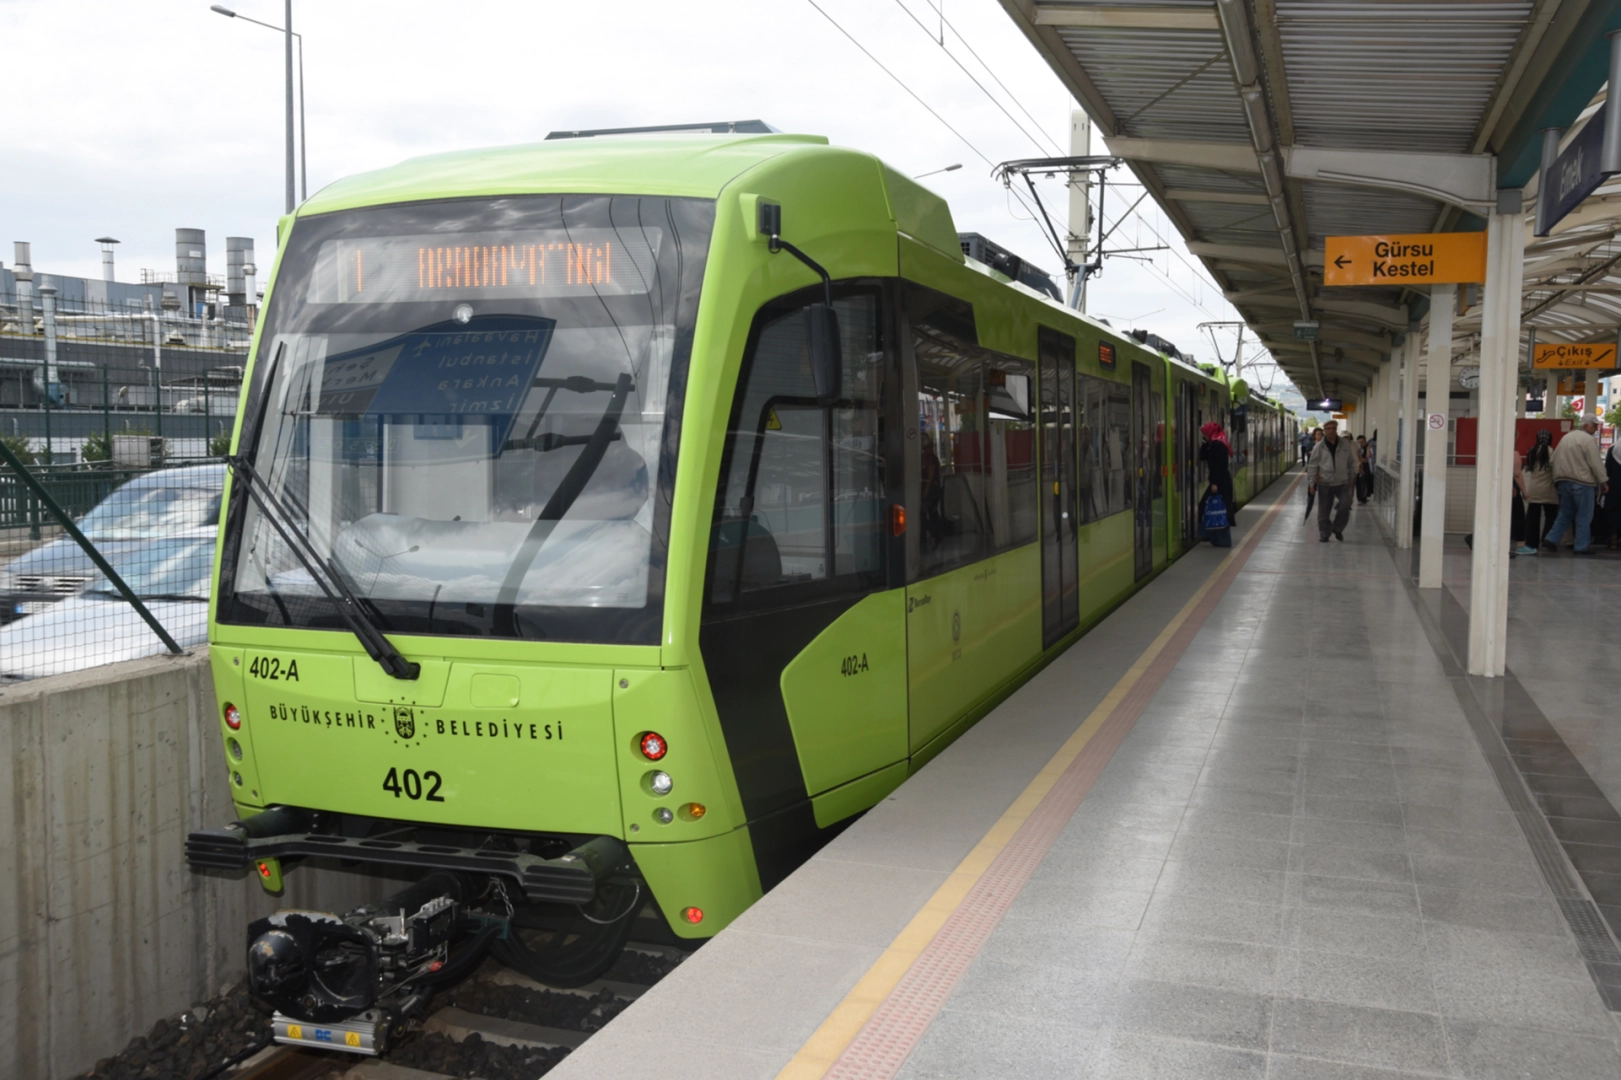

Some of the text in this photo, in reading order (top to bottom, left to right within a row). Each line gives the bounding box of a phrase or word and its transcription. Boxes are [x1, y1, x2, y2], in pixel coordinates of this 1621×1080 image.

[1374, 241, 1433, 259] Gürsu
[1373, 259, 1434, 277] Kestel
[1557, 346, 1592, 358] Çıkış
[249, 656, 300, 682] 402-A
[841, 652, 869, 677] 402-A
[270, 703, 564, 741] BÜYÜKŞEHİR BELEDİYESİ
[382, 767, 445, 803] 402
